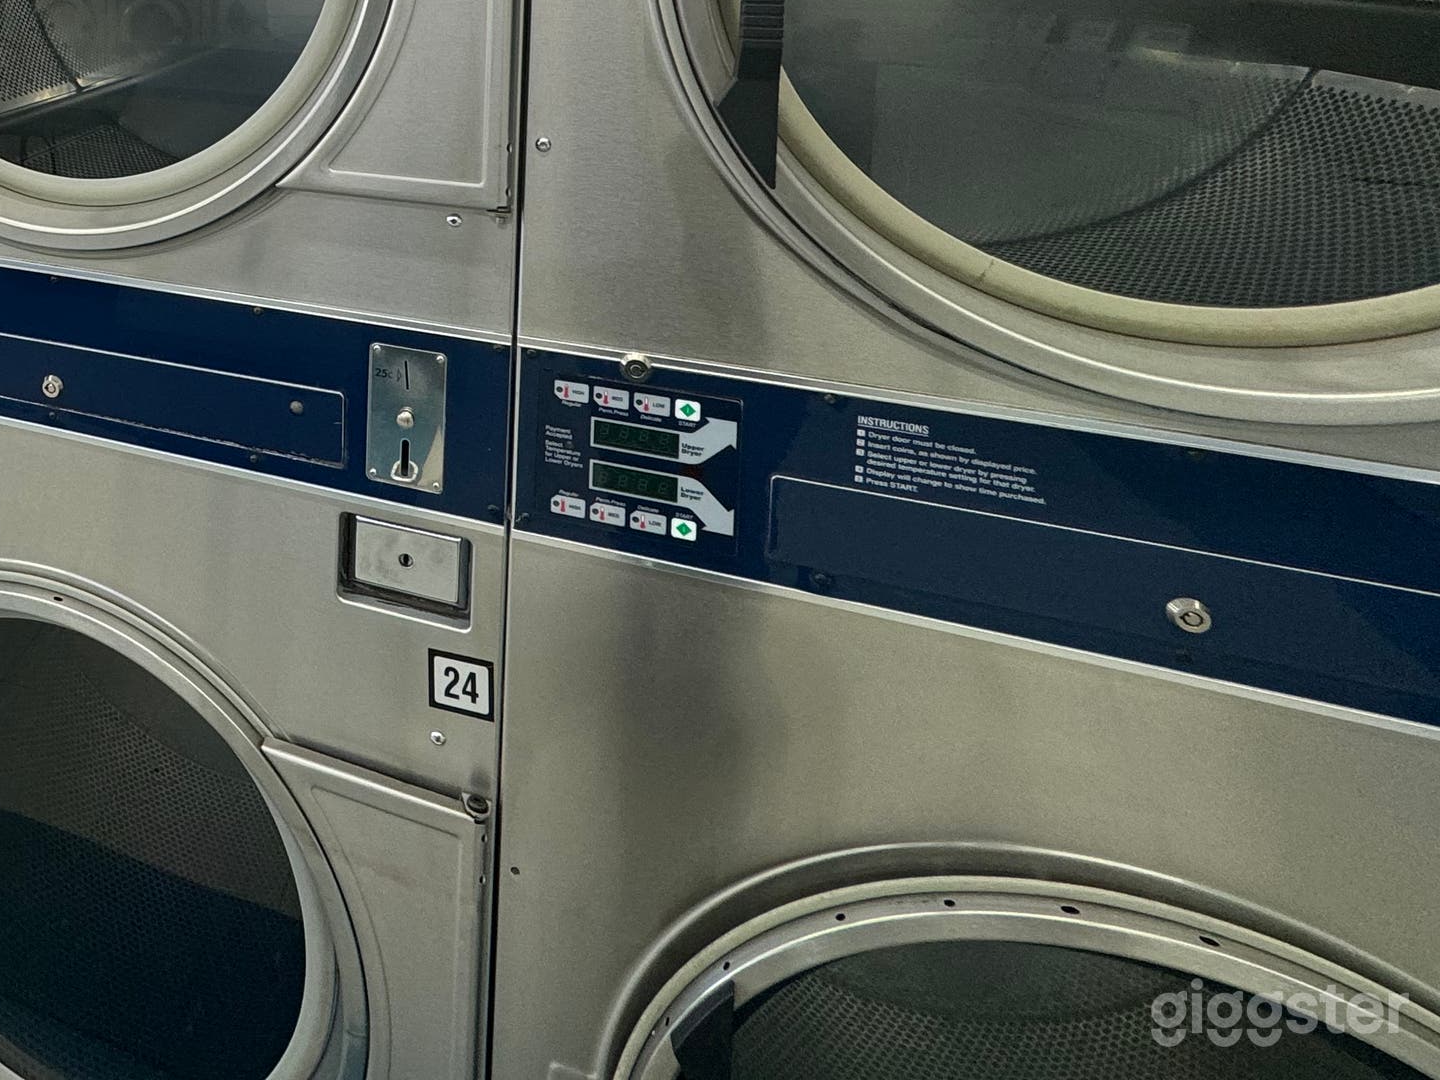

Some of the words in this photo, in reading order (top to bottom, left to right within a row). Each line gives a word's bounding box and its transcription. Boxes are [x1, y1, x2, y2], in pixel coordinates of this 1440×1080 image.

[857, 415, 930, 435] INSTRUCTIONS
[868, 431, 891, 440] Dryer
[913, 439, 933, 448] must
[934, 442, 945, 450] be
[867, 451, 892, 460] Select
[894, 456, 917, 465] upper
[954, 466, 976, 475] dryer
[978, 469, 989, 478] by
[959, 456, 969, 465] by
[866, 467, 896, 480] Display
[443, 665, 479, 705] 24
